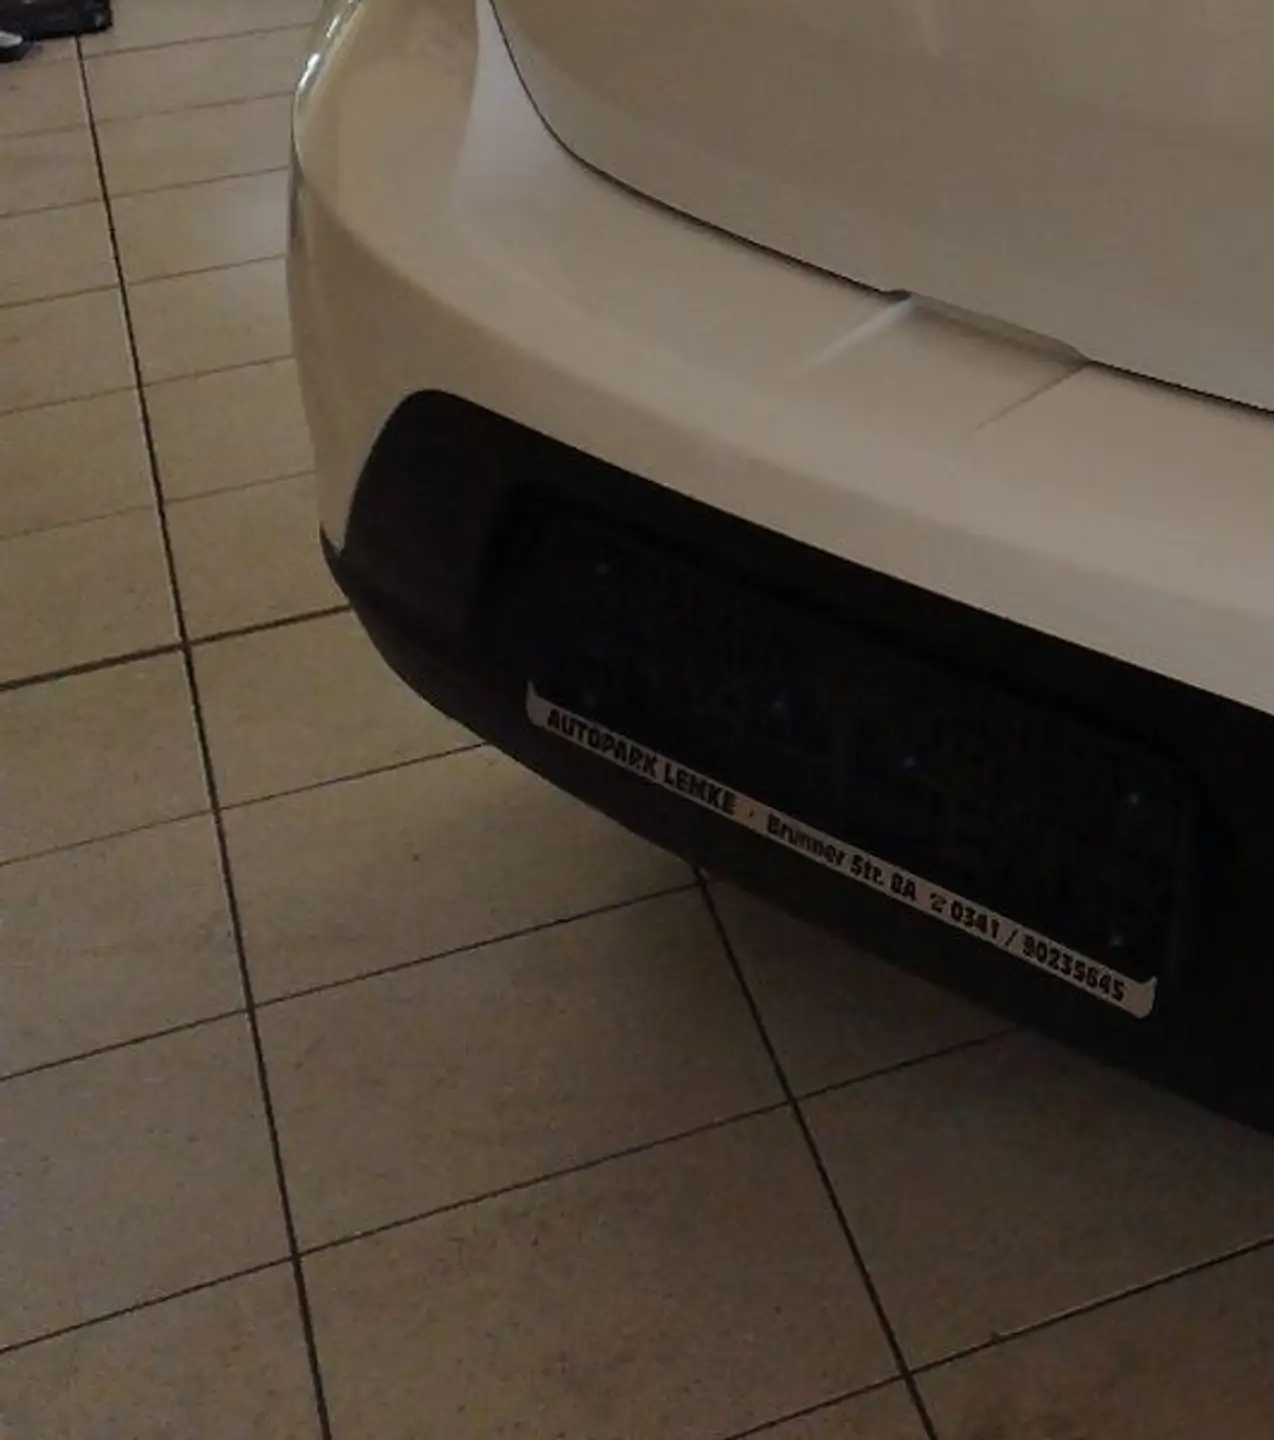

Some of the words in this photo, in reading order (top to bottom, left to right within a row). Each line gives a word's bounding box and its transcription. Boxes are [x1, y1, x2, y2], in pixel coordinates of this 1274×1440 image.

[546, 708, 658, 778] AUTOPARK
[663, 762, 737, 815] LEMKE
[850, 853, 884, 887] Str.
[950, 901, 1001, 940] 0341
